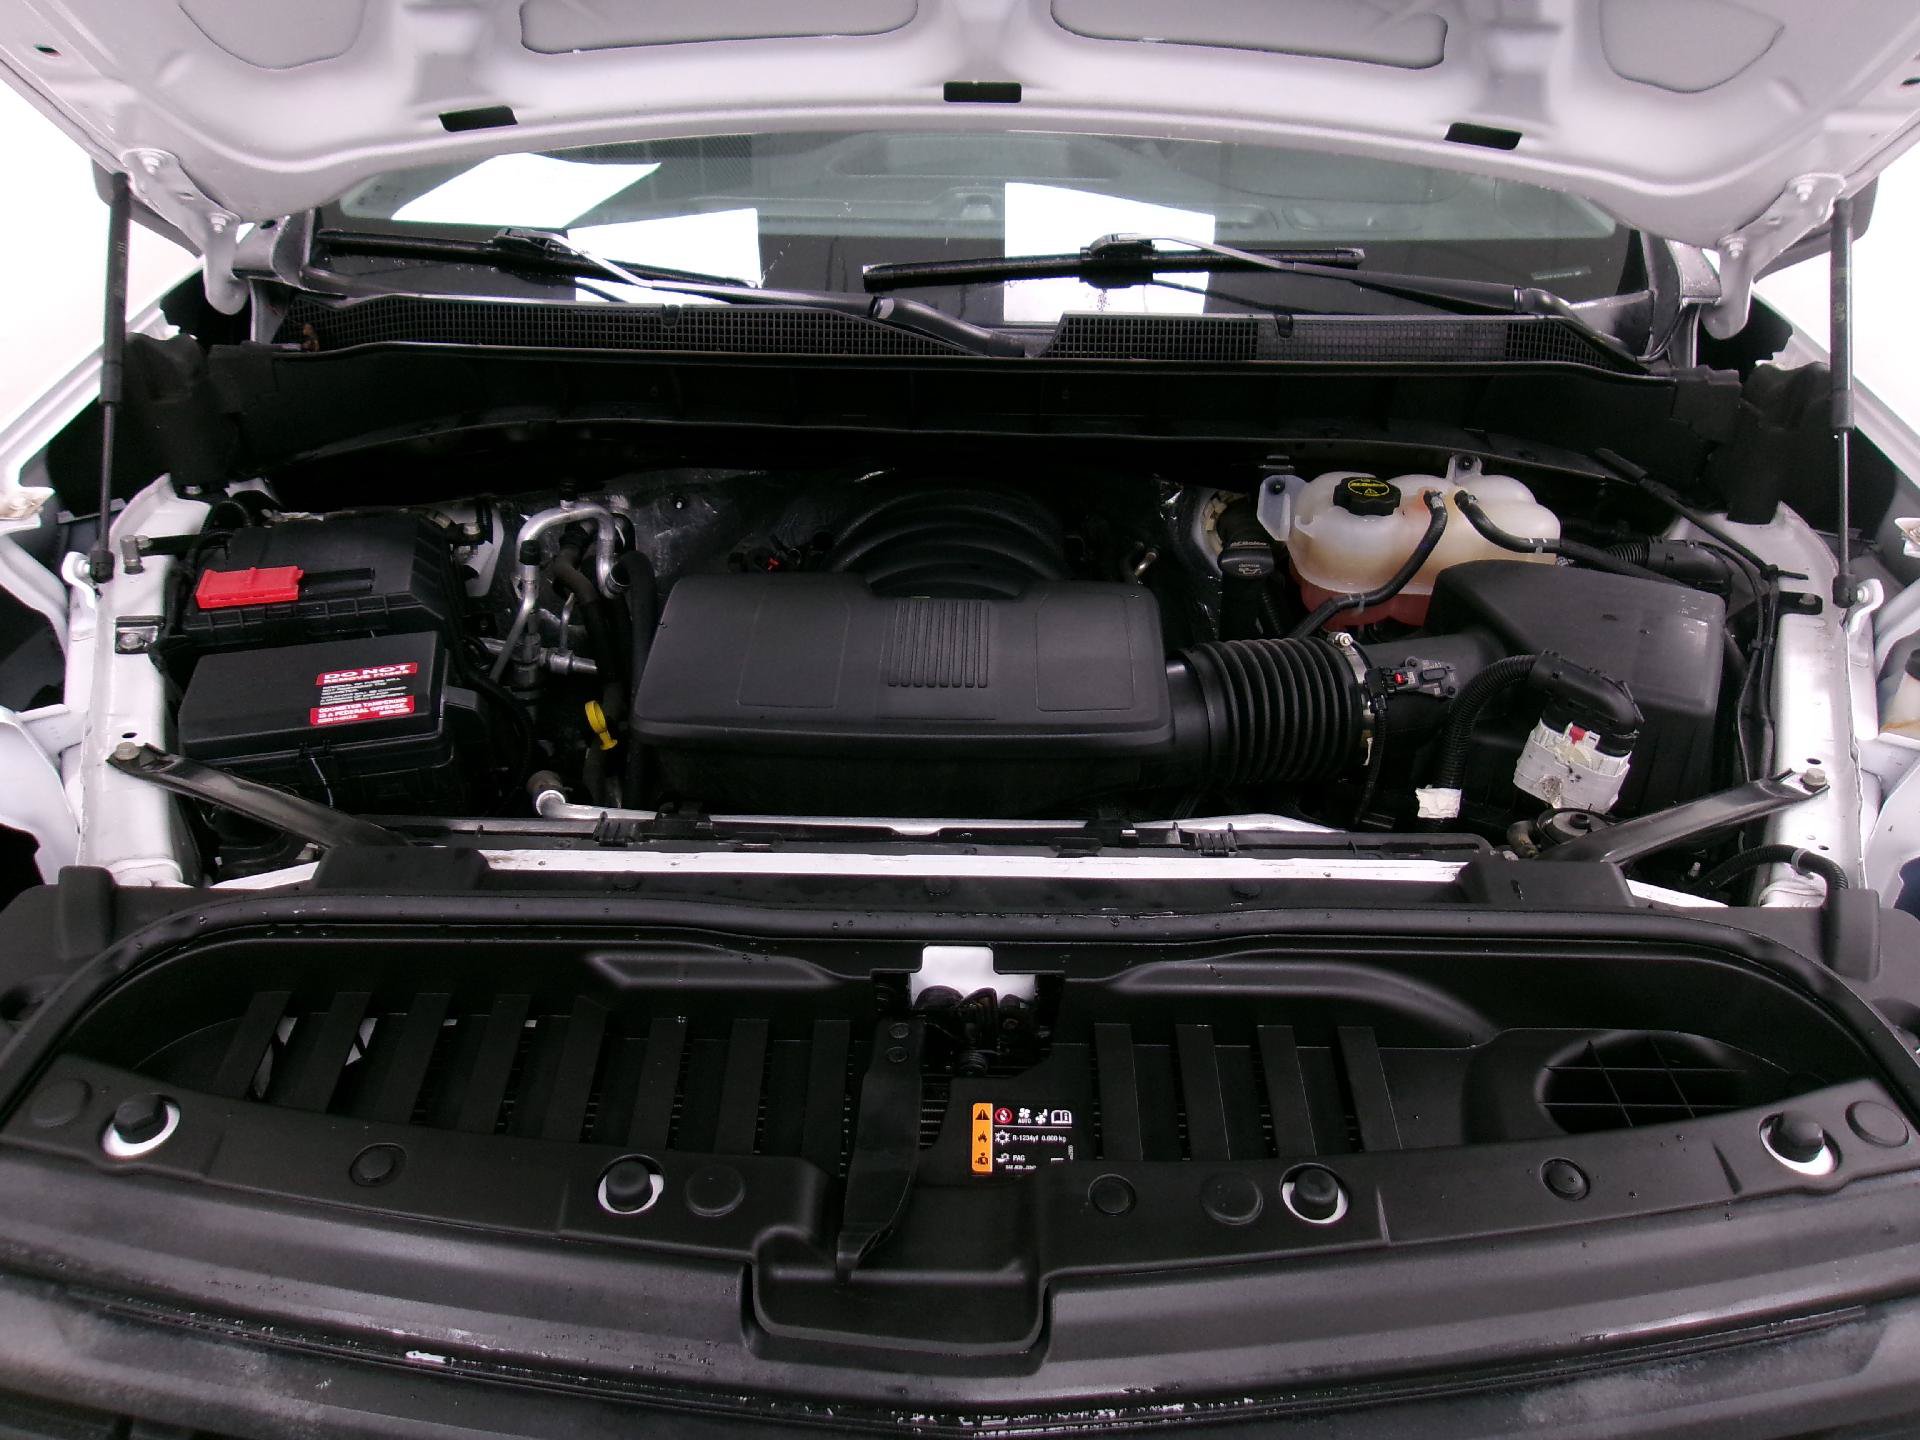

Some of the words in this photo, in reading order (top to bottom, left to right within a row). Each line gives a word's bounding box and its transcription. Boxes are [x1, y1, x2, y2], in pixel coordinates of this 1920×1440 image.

[324, 671, 358, 680] DO
[362, 664, 411, 675] NOT
[323, 674, 371, 684] REMOVE
[1012, 1154, 1026, 1162] PAG
